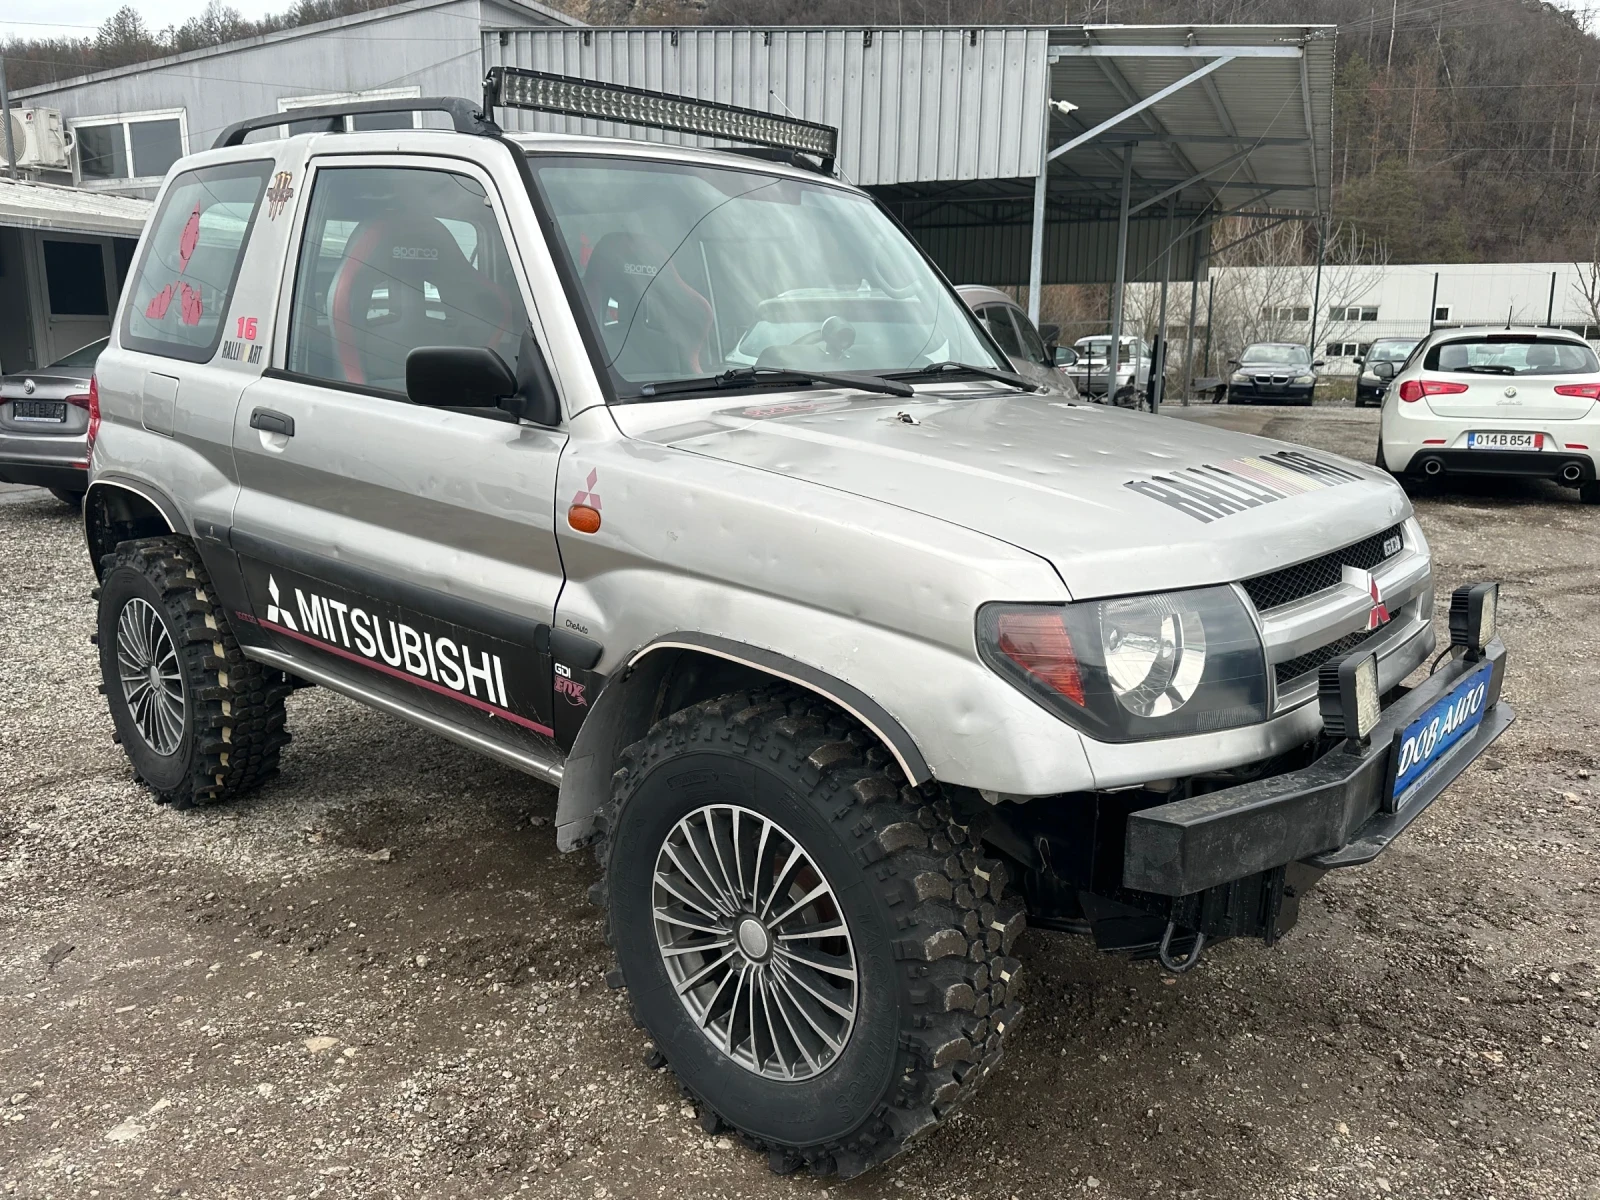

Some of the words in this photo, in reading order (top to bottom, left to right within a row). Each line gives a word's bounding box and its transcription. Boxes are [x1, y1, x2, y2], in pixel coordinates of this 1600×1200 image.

[392, 246, 438, 260] sparco
[624, 263, 657, 276] sparco
[237, 316, 258, 341] 16
[221, 340, 242, 361] RALLI
[247, 344, 263, 365] ART
[1123, 463, 1288, 524] RALLI
[565, 619, 589, 635] CheAuto
[294, 588, 509, 708] MITSUBISHI
[554, 662, 572, 679] GDI
[1397, 716, 1440, 777] DOB
[1437, 681, 1486, 743] AUTO
